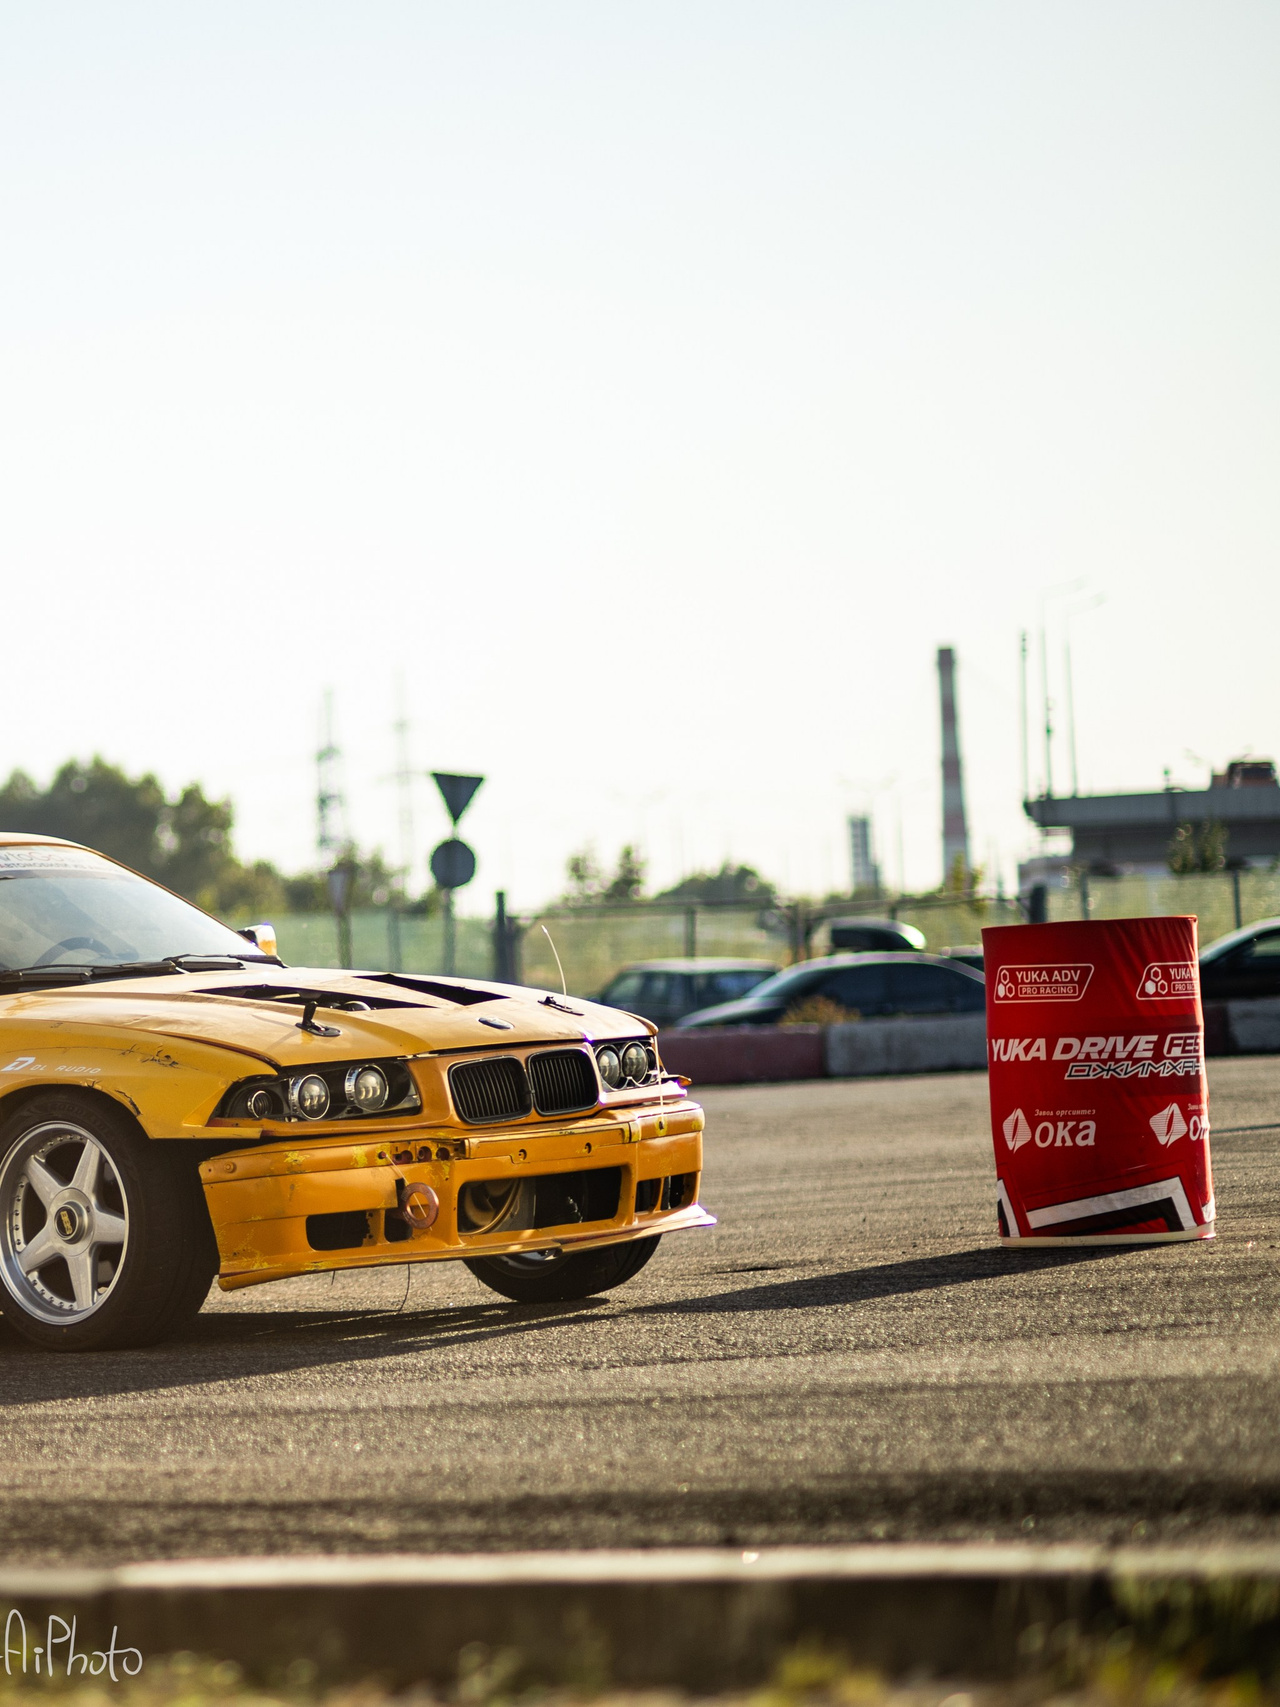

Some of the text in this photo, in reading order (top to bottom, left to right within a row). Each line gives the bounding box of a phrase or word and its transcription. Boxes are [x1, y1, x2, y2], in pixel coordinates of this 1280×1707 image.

[1016, 970, 1081, 983] YUKA ADV
[1022, 986, 1074, 995] PRO RACING
[991, 1038, 1047, 1062] YUKA
[1052, 1035, 1159, 1061] DRIVE
[55, 1065, 102, 1074] AUDIO
[1064, 1058, 1204, 1080] ДЖИМХАН
